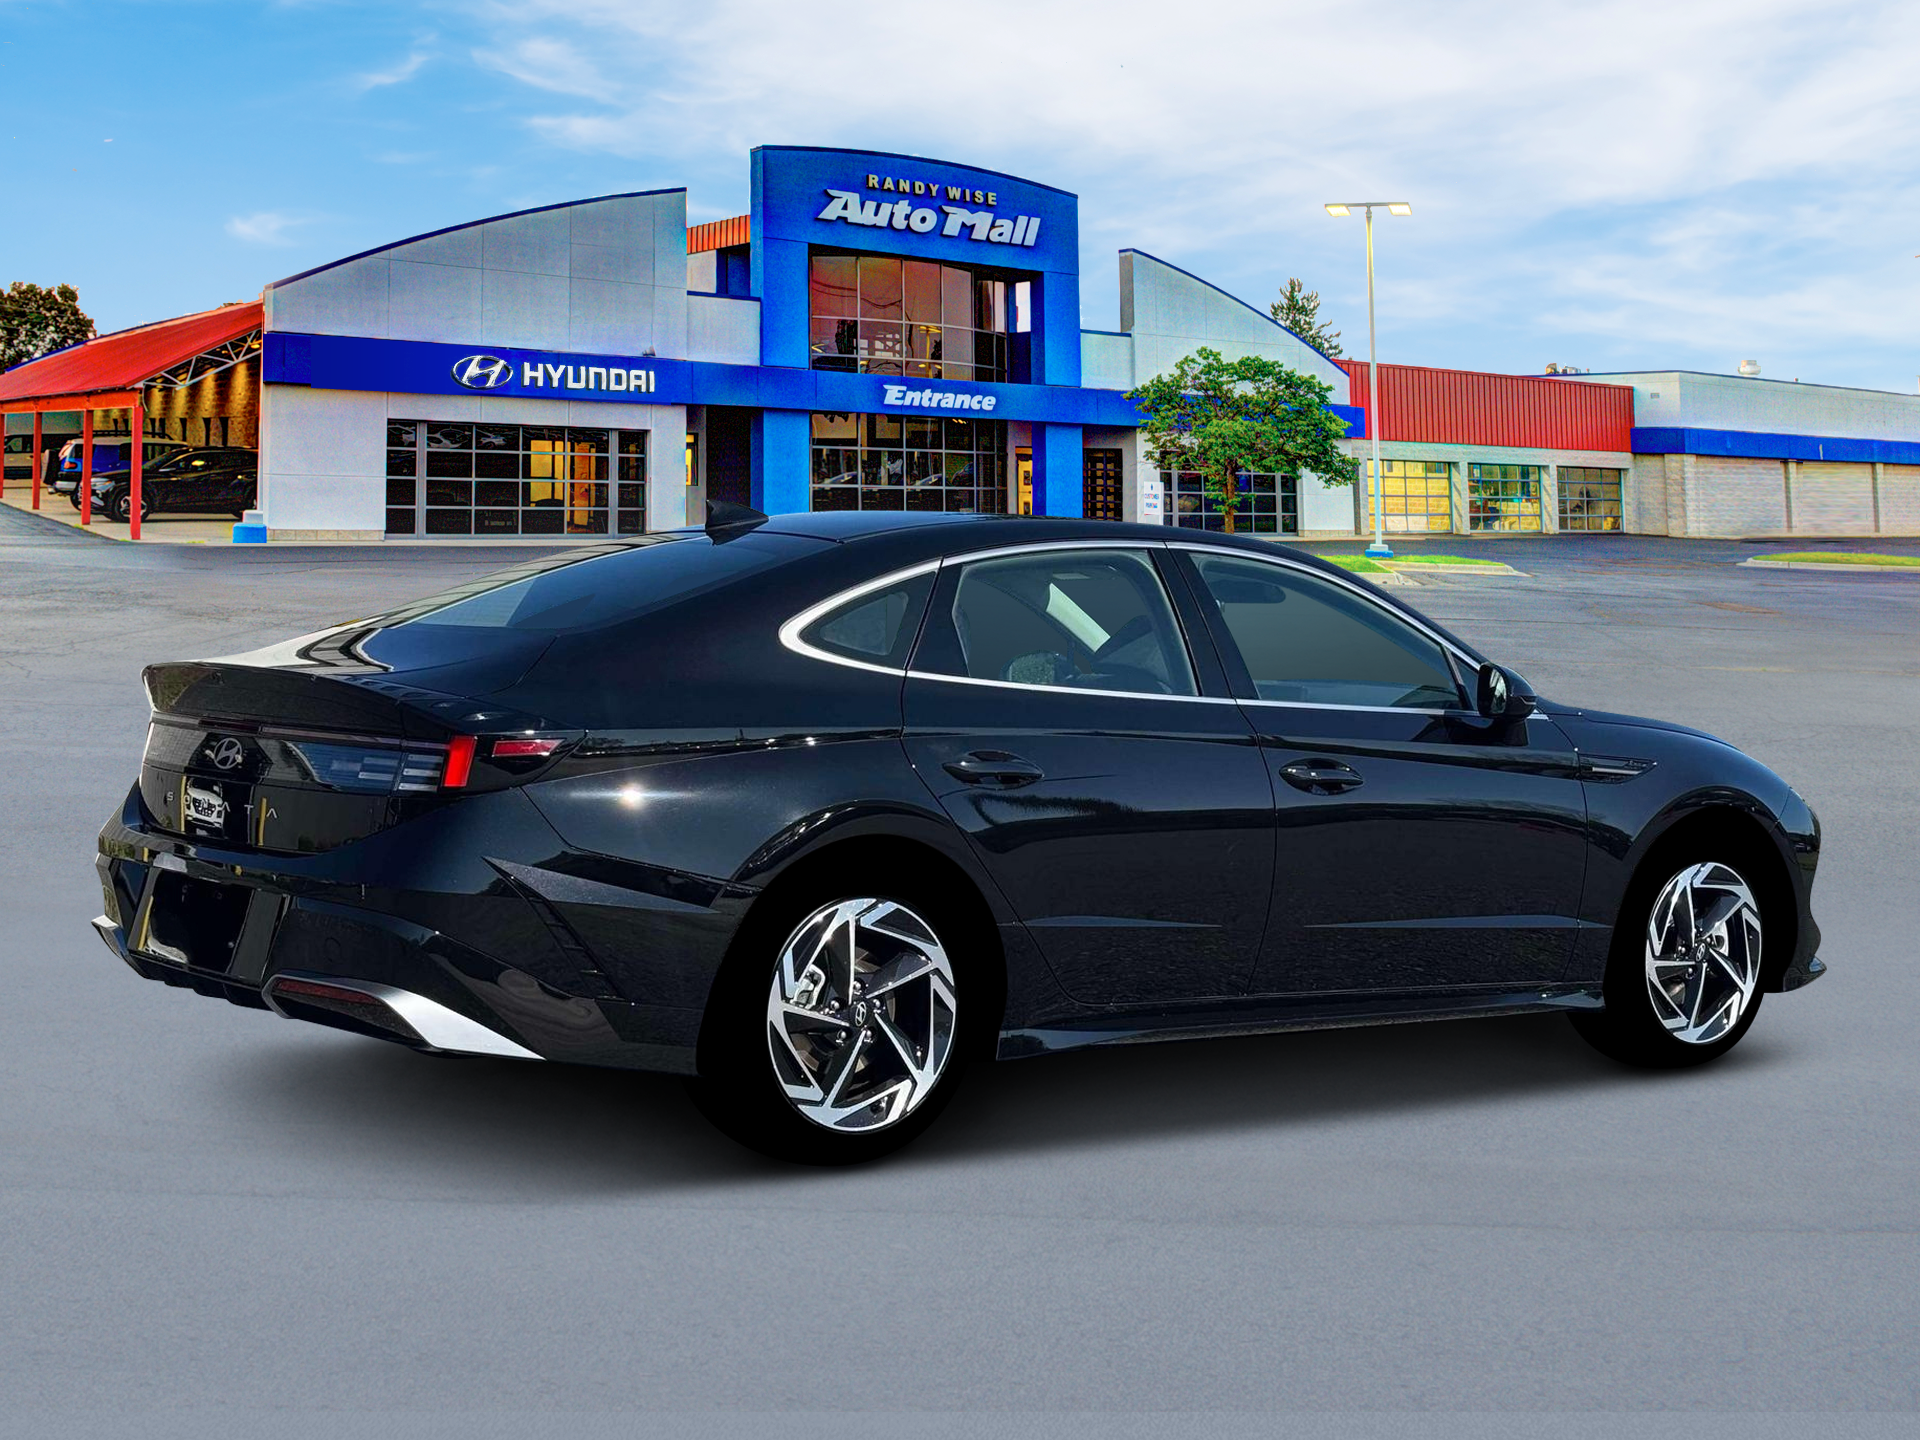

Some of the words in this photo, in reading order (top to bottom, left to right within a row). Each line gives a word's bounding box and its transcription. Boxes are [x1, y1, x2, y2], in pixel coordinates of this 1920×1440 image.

[866, 174, 939, 197] RANDY
[946, 186, 998, 206] WISE
[816, 188, 938, 233] Auto
[940, 205, 1041, 247] Mall
[521, 362, 655, 393] HYUNDAI
[883, 384, 997, 411] Entrance
